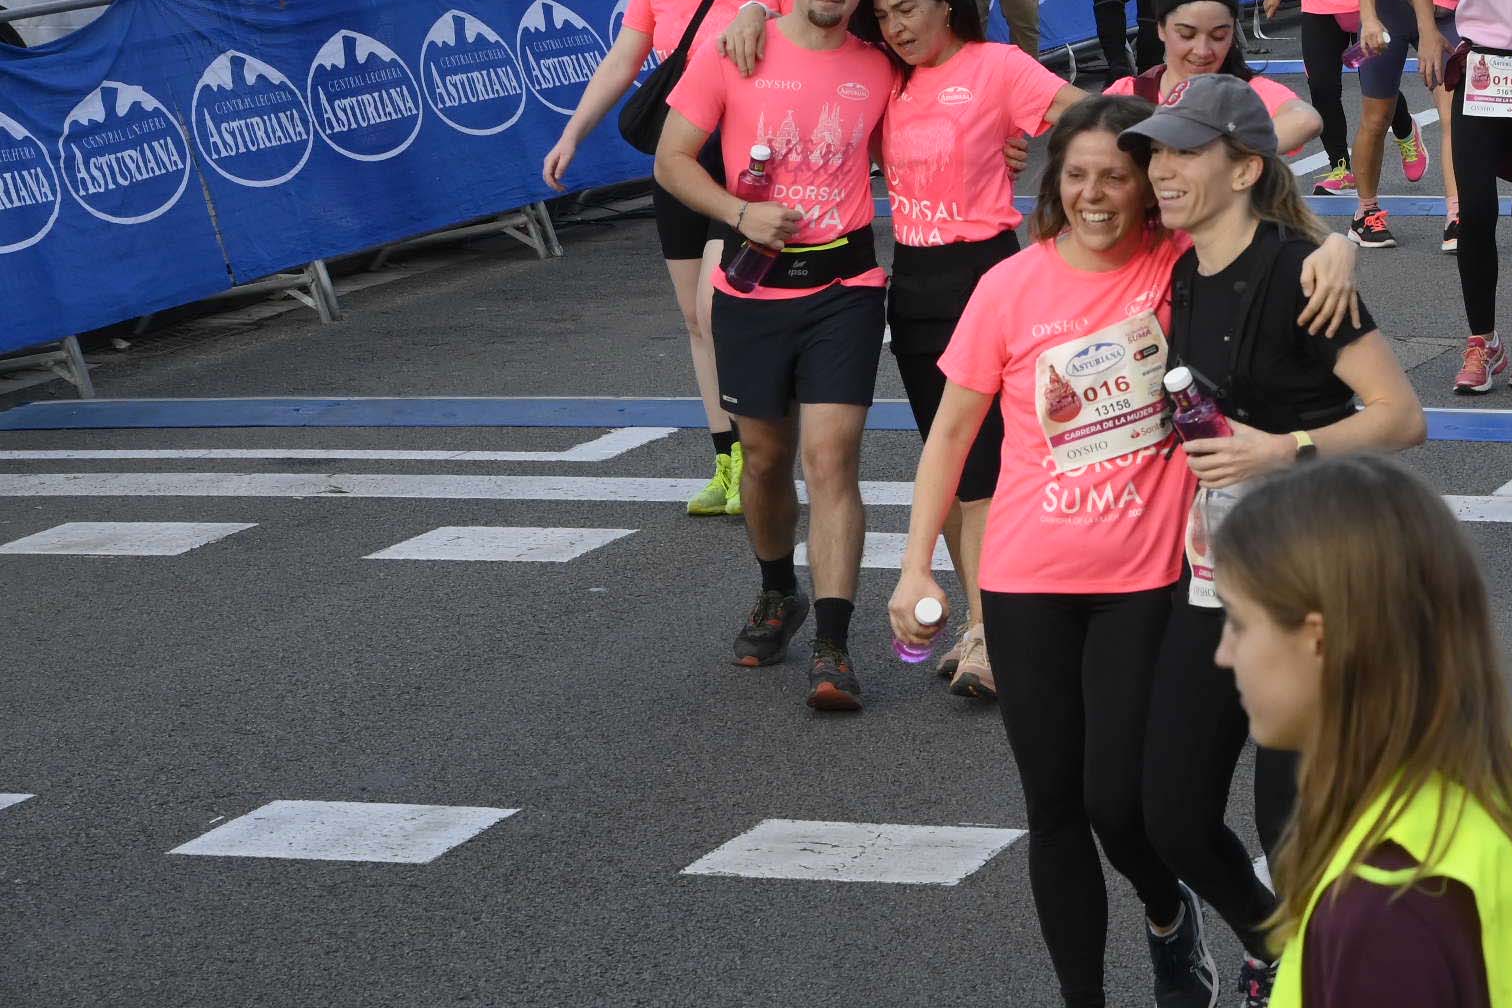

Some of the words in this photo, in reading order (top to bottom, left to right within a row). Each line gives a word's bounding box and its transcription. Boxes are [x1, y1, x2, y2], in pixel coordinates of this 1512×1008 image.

[440, 53, 473, 67] CENTRAL
[475, 48, 507, 63] LECHERA
[328, 74, 363, 92] CENTRAL
[367, 67, 402, 84] LECHERA
[430, 62, 522, 109] ASTURIANA
[755, 79, 802, 91] OYSHO
[255, 90, 292, 107] LECHERA
[318, 85, 418, 135] ASTURIANA
[82, 130, 124, 149] CENTRAL
[204, 107, 308, 160] ASTURIANA
[71, 137, 184, 196] ASTURIANA
[1032, 317, 1089, 339] OYSHO
[1071, 349, 1123, 375] ASTURIANA
[1084, 375, 1131, 402] 016
[1094, 398, 1132, 418] 13158
[1064, 424, 1102, 441] CARRERA
[1103, 421, 1115, 431] DE
[1115, 417, 1127, 427] LA
[1126, 406, 1154, 422] MUJER
[1066, 441, 1109, 460] OYSHO
[1043, 479, 1144, 514] SUMA
